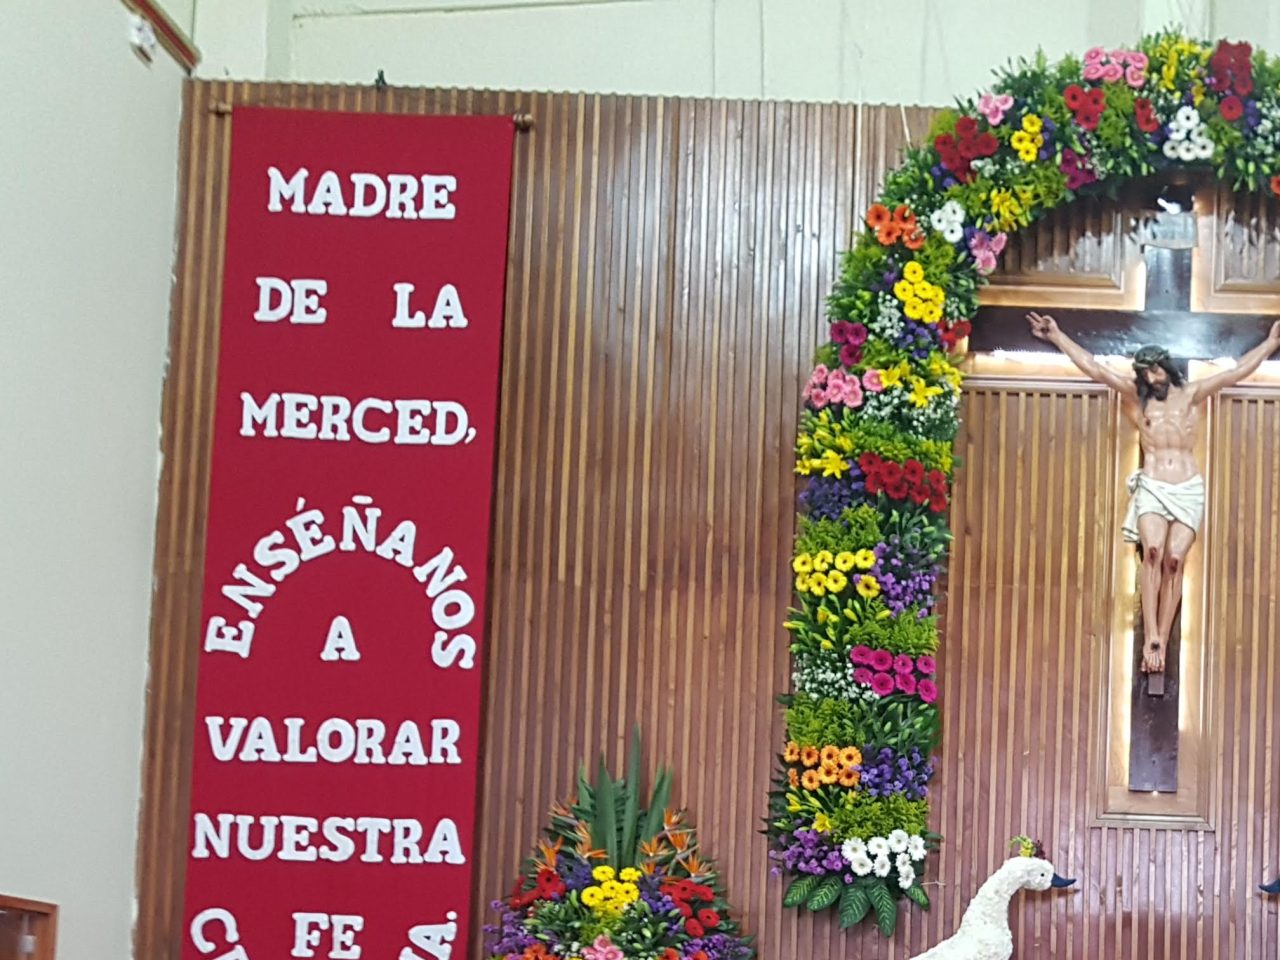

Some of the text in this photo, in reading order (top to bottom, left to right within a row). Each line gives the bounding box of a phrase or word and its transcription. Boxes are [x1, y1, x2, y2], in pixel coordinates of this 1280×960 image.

[268, 167, 456, 219] MADRE
[254, 277, 469, 328] DE LA
[239, 392, 477, 445] MERCED,
[204, 495, 477, 669] ENSÉÑANOS
[320, 616, 361, 661] A
[204, 716, 462, 766] VALORAR
[191, 812, 466, 865] NUESTRA
[291, 912, 365, 960] FE
